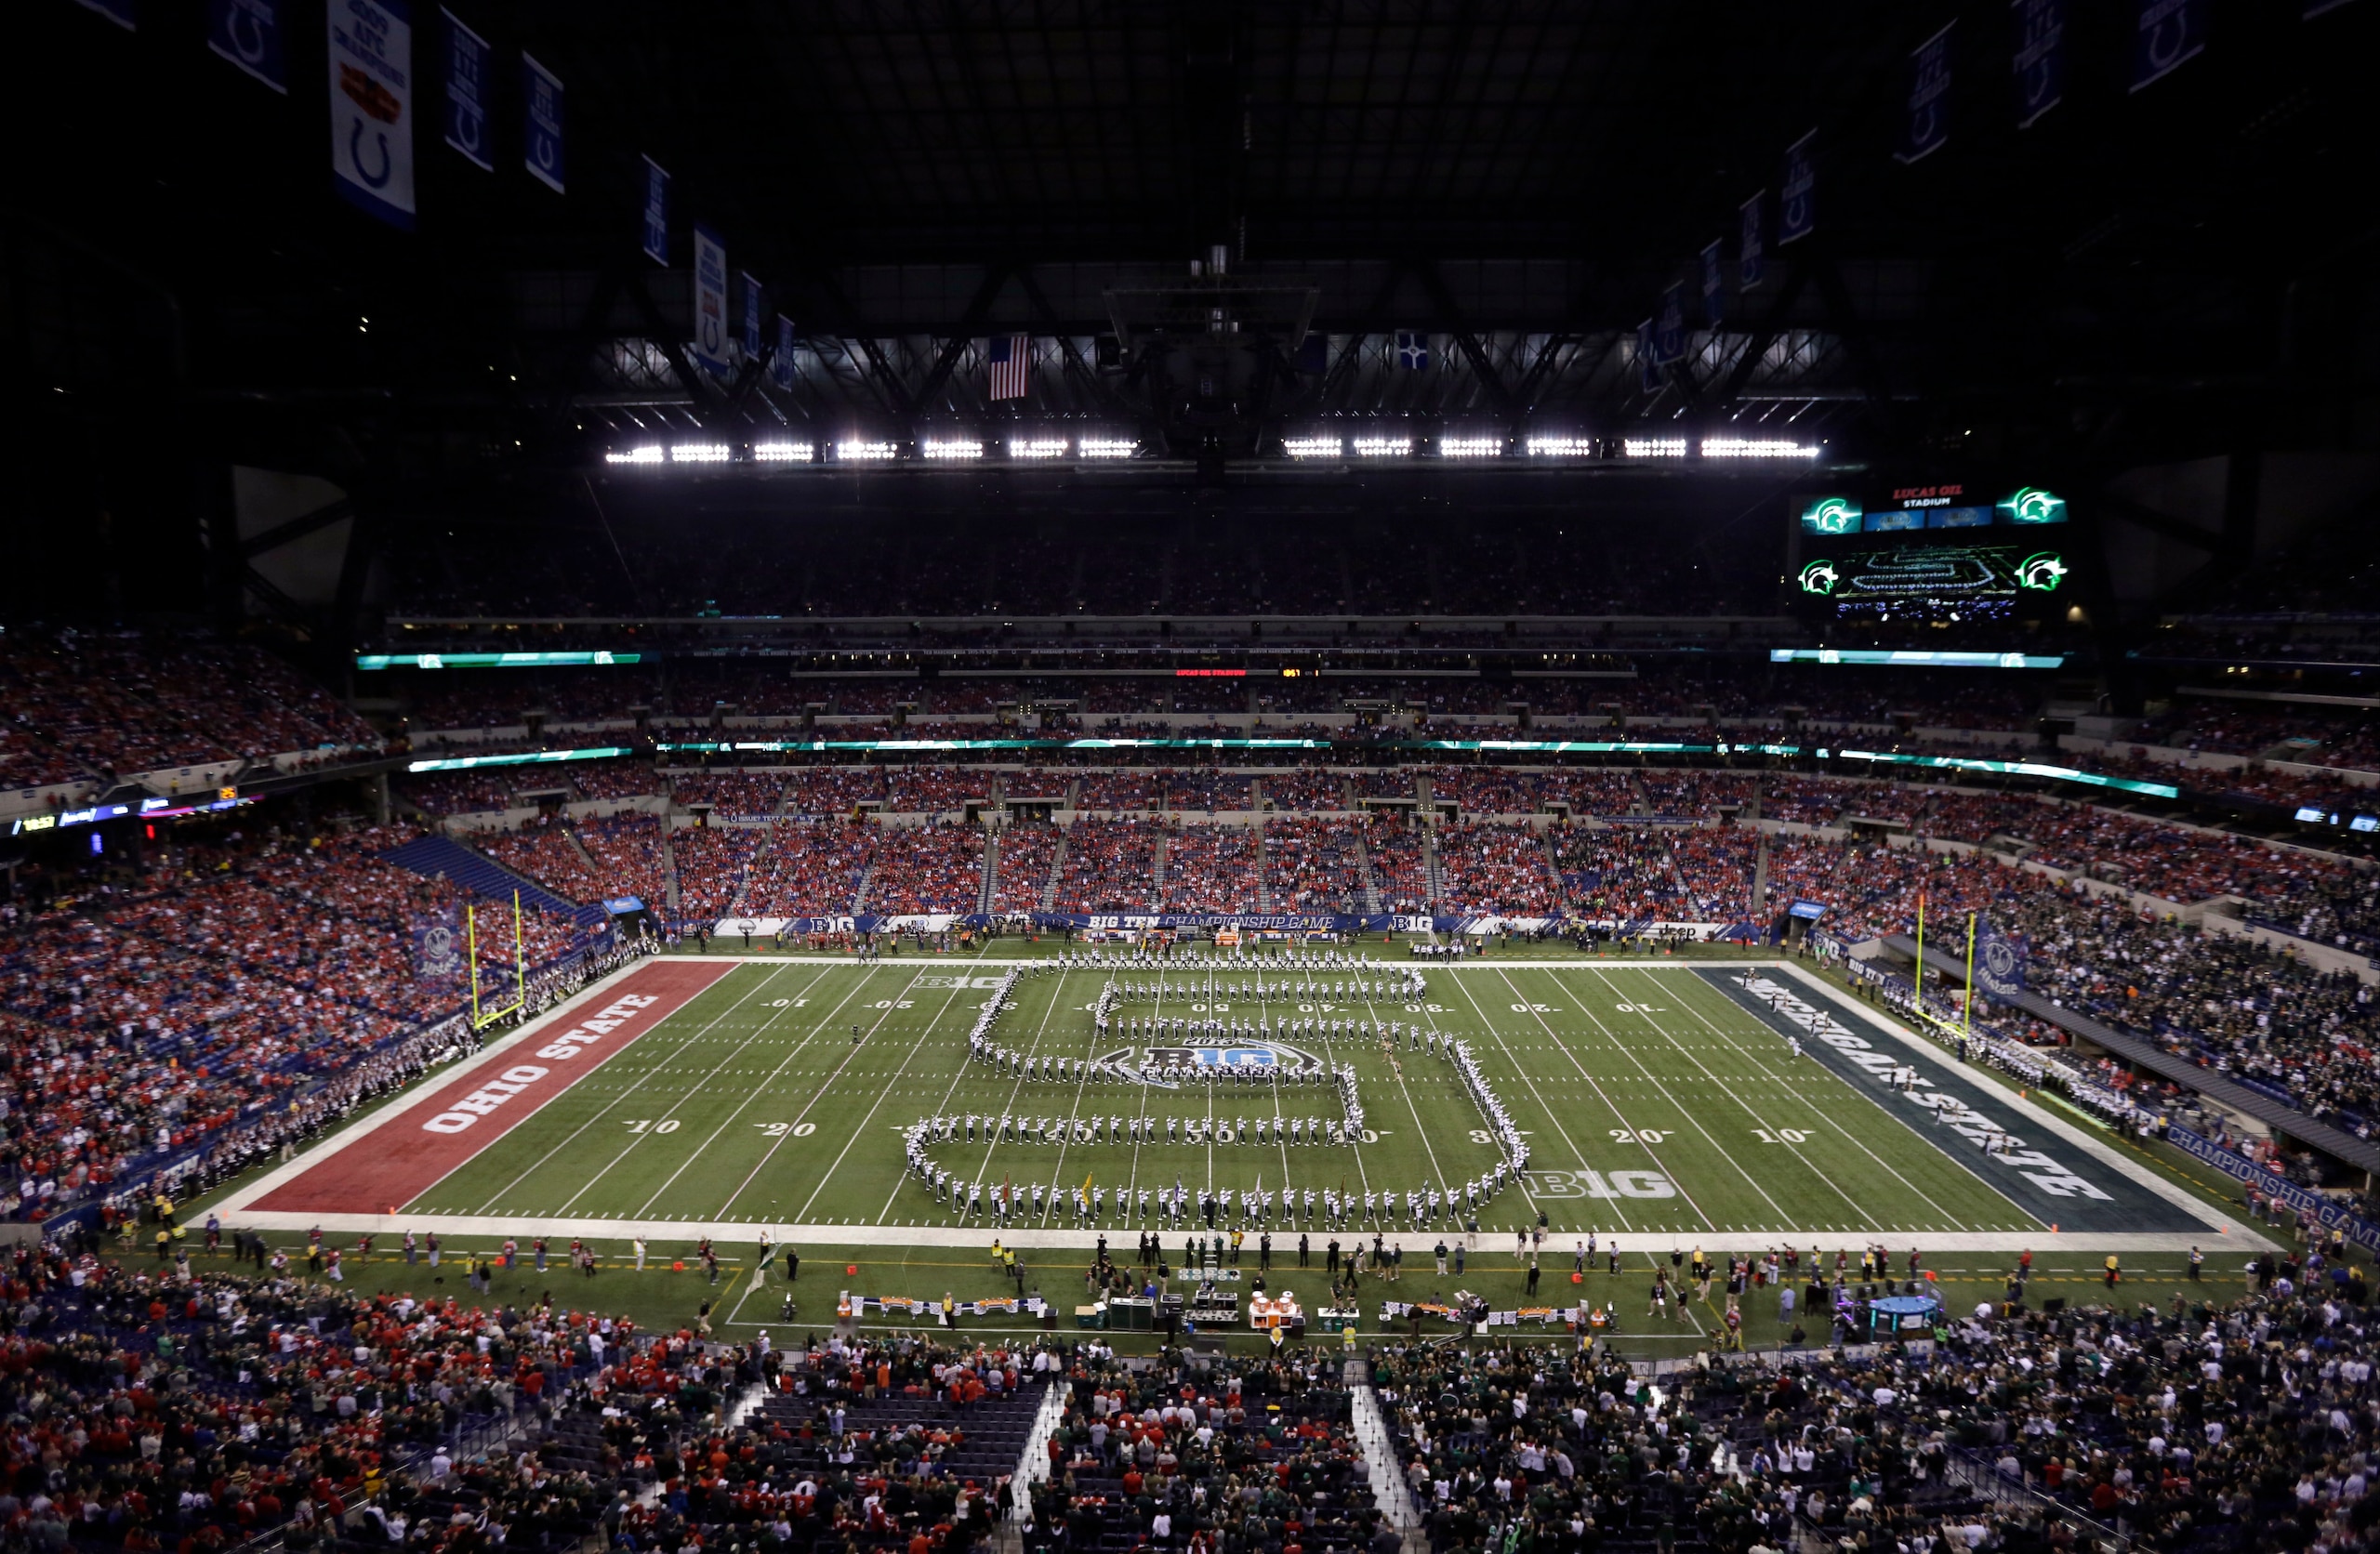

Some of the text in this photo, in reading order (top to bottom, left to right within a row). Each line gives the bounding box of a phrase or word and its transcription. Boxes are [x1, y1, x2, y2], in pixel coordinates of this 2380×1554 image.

[1893, 484, 1964, 500] LUCAS OIL
[1903, 497, 1951, 508] STADIUM
[1176, 668, 1247, 677] LUCAS OIL STADIUM
[1089, 915, 1334, 928] BIG TEN CHAMPIONSHIP GAME
[1848, 958, 1865, 975] BIG
[1183, 1037, 1236, 1046] 2013
[422, 993, 660, 1134] OHIO STATE
[629, 1120, 681, 1133] 10
[764, 1121, 816, 1137] 20
[1609, 1129, 1665, 1144] 20
[1752, 1128, 1806, 1143] 10
[1903, 1091, 2115, 1201] STATE
[2167, 1126, 2316, 1210] CHAMPIONSHIP
[1522, 1169, 1677, 1199] BIG
[745, 1495, 750, 1504] 2
[760, 1501, 767, 1509] 7
[785, 1501, 792, 1510] 2
[631, 1513, 639, 1524] 4
[939, 1532, 946, 1543] 7
